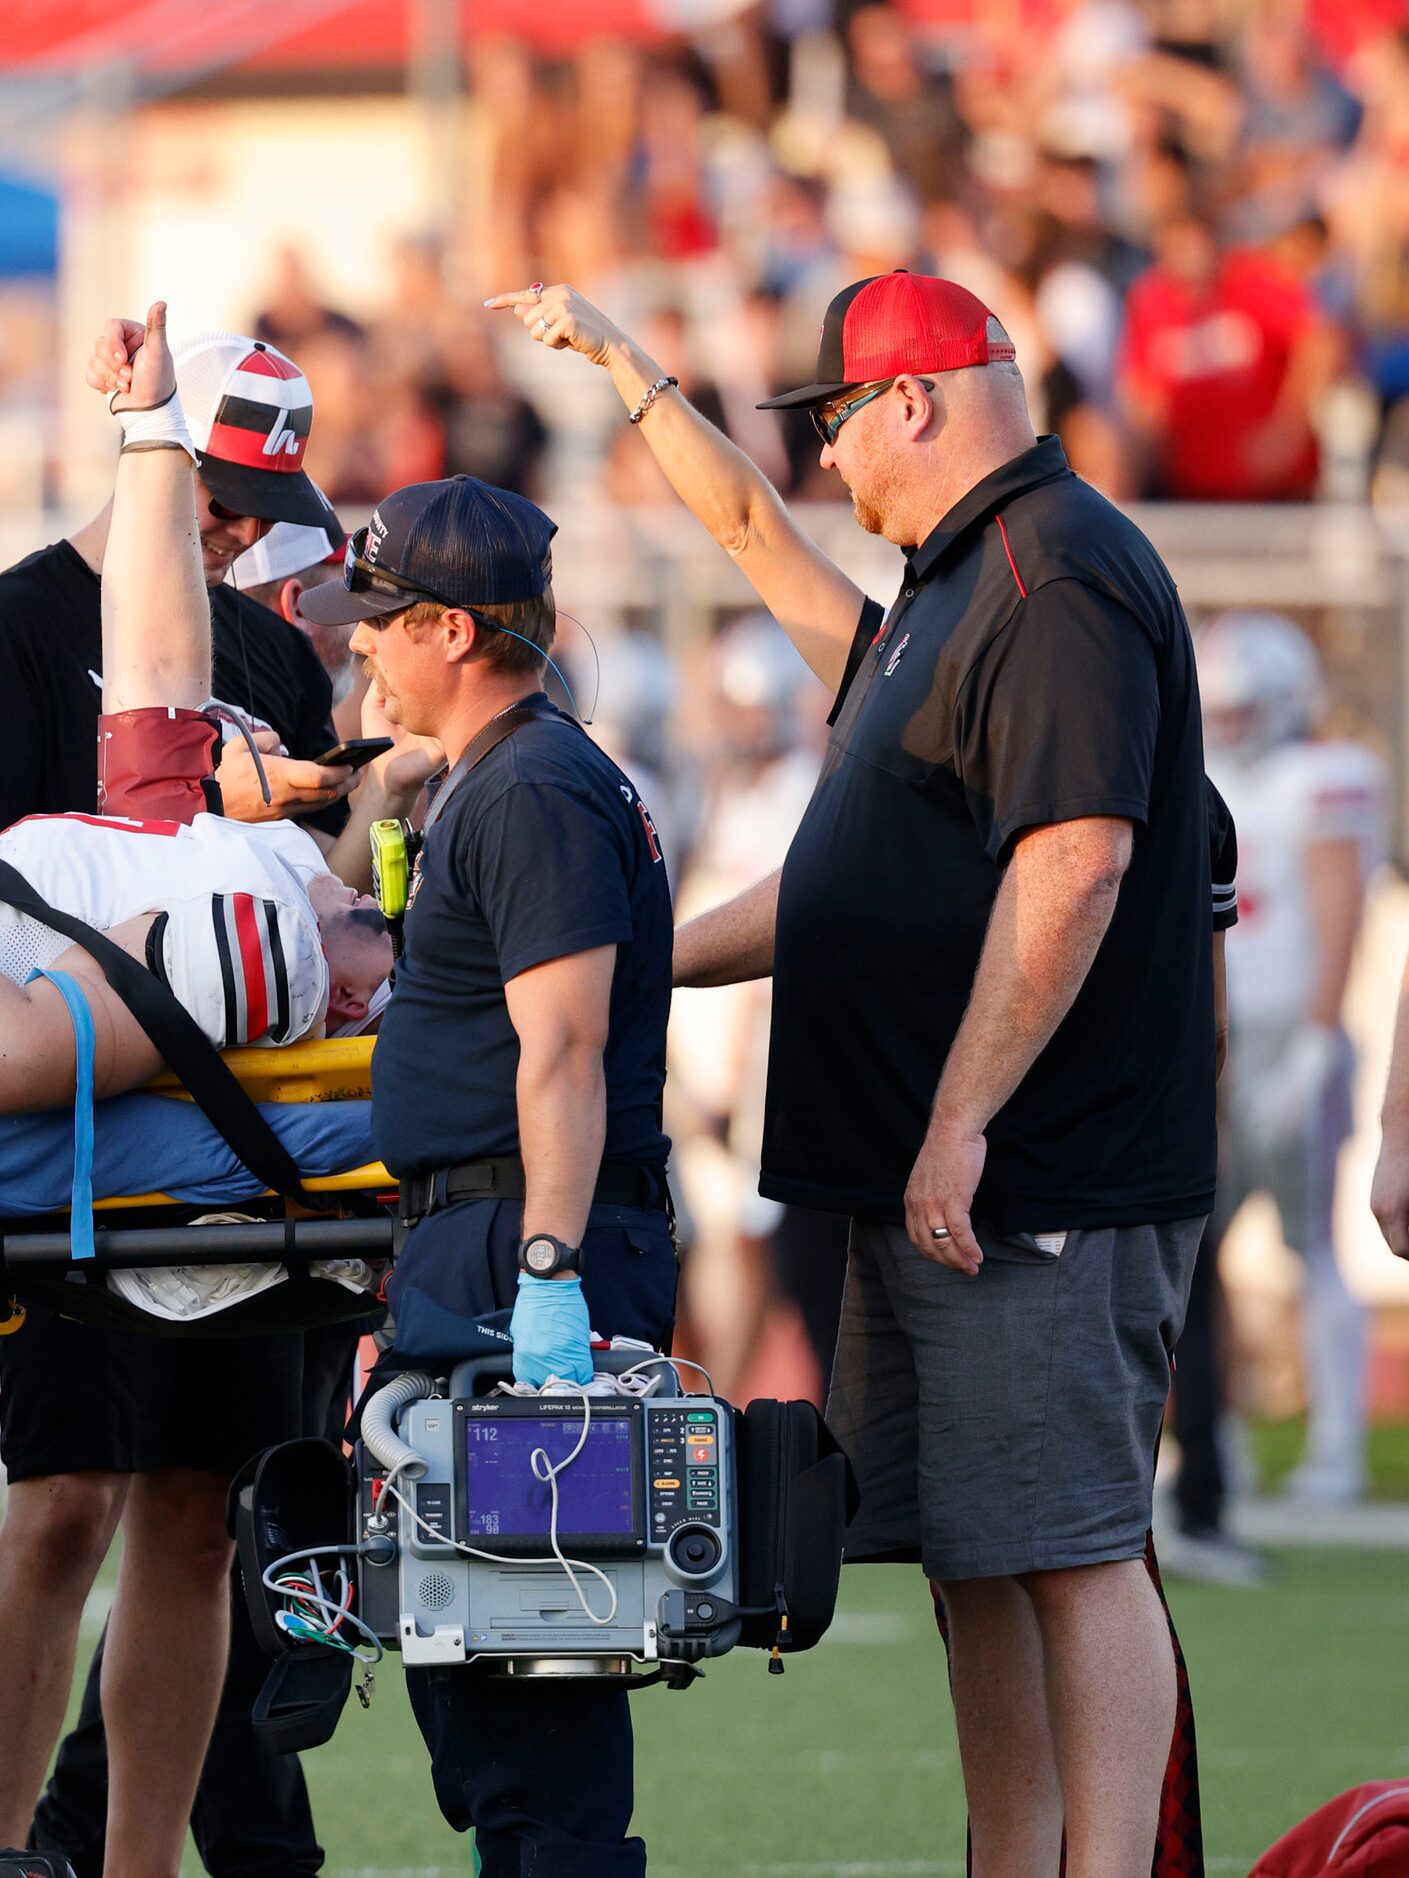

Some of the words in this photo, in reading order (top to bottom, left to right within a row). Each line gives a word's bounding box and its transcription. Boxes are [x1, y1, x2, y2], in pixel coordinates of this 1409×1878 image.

[476, 1324, 495, 1337] THIS
[471, 1404, 500, 1412] stryker
[473, 1427, 498, 1441] 112
[480, 1514, 500, 1525] 183
